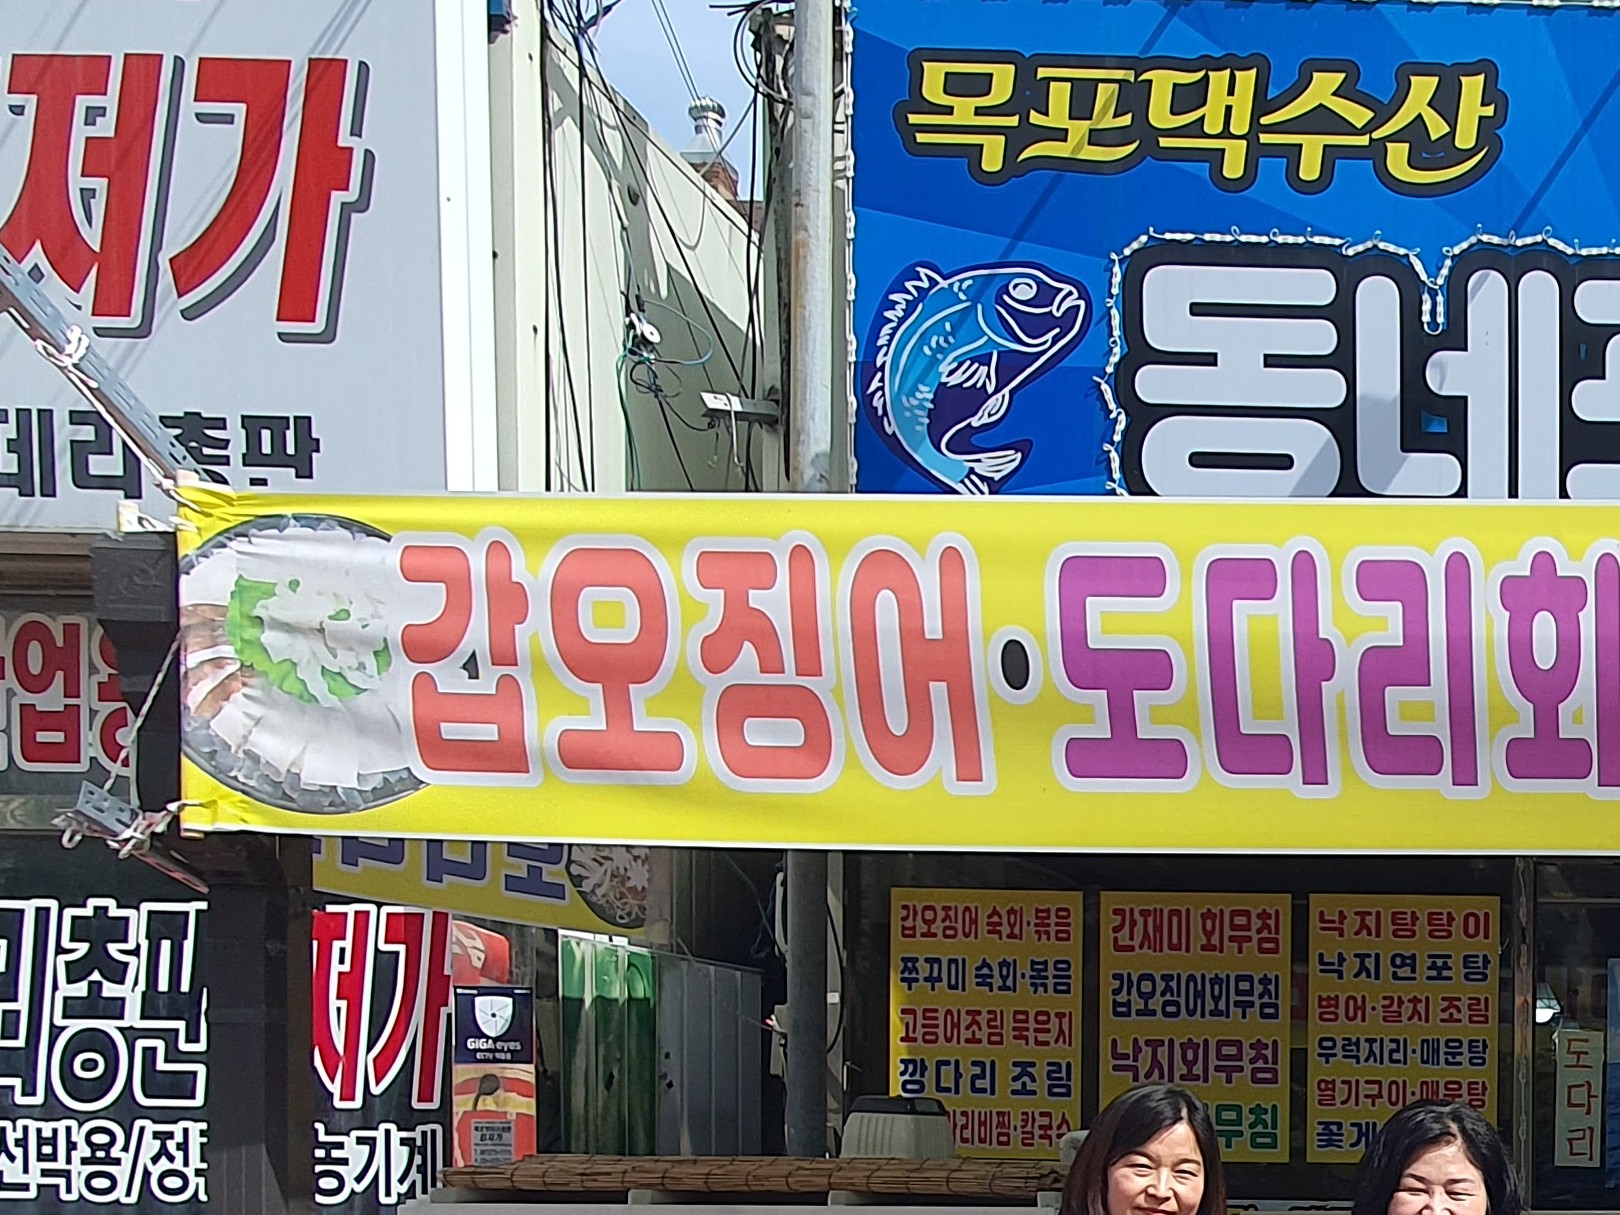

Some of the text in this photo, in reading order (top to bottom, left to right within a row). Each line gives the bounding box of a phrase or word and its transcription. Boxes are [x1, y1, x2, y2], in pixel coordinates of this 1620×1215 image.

[905, 61, 1497, 185] 목포댁수산
[900, 904, 1072, 942] 갑오징어 숙회·볶음
[1112, 907, 1281, 956] 간재미 회무침
[1318, 910, 1491, 941] 낙지탕탕이
[900, 956, 1072, 995] 쭈꾸미 숙회·볶음
[1318, 952, 1492, 983] 낙지연포탕
[1112, 972, 1281, 1020] 갑오징어회무침
[1317, 994, 1490, 1025] 병어·갈치 조림
[466, 1037, 522, 1052] GIGA eyes
[900, 1008, 1073, 1047] 고등어조림 묵은지
[1111, 1037, 1280, 1085] 낙지회무침
[1317, 1037, 1489, 1066] 우럭지리·매운탕
[899, 1058, 1072, 1098] 깡다리 조림
[1564, 1038, 1598, 1163] 도다리
